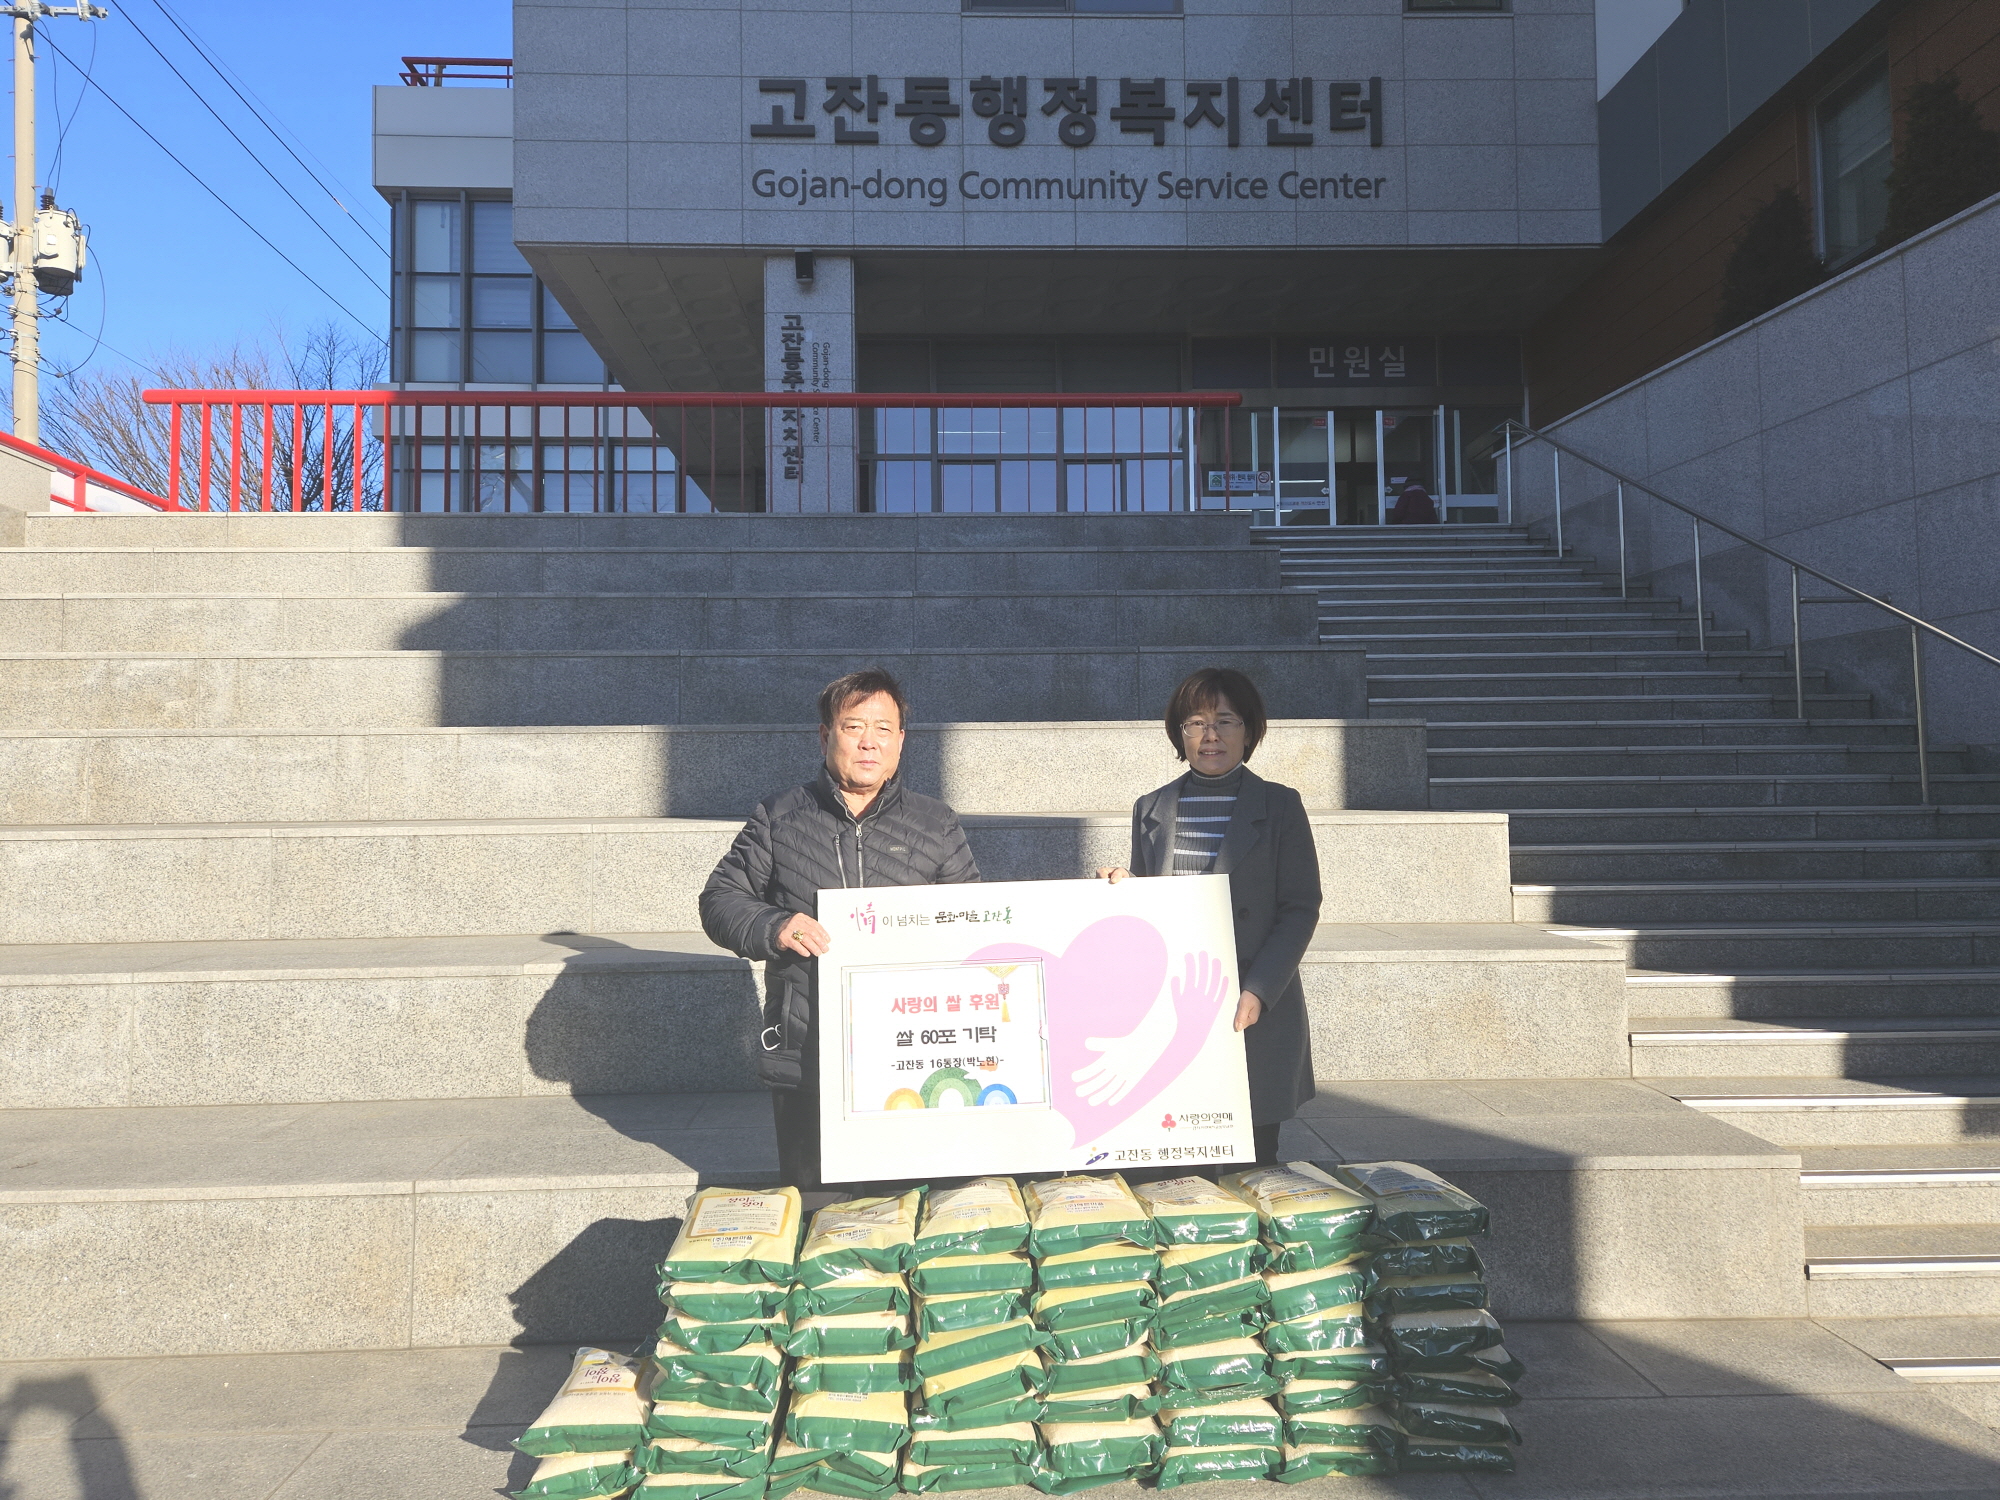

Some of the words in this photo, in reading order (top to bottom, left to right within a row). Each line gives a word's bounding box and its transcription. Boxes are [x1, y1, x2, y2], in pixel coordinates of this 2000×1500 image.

[751, 74, 1383, 147] 고잔동행정복지센터
[752, 168, 948, 207] Gojan-dong
[958, 170, 1149, 207] Community
[1157, 170, 1269, 200] Service
[1278, 170, 1387, 200] Center
[811, 342, 820, 388] Community
[823, 342, 831, 389] Gojan-dong
[1309, 346, 1406, 378] 민원실
[781, 315, 805, 484] 고잔동주자치센터
[812, 418, 821, 444] Center
[897, 914, 930, 927] 넘치는
[982, 906, 1013, 925] 고잔동
[891, 995, 938, 1014] 사랑의
[945, 995, 962, 1012] 쌀
[969, 993, 1000, 1011] 후원
[896, 1029, 915, 1047] 쌀
[920, 1029, 957, 1045] 60포
[962, 1025, 997, 1044] 기탁
[891, 1059, 924, 1071] -고잔동
[1179, 1112, 1233, 1126] 사랑의열매
[1114, 1149, 1152, 1162] 고잔동
[1158, 1144, 1234, 1160] 행정복지센터
